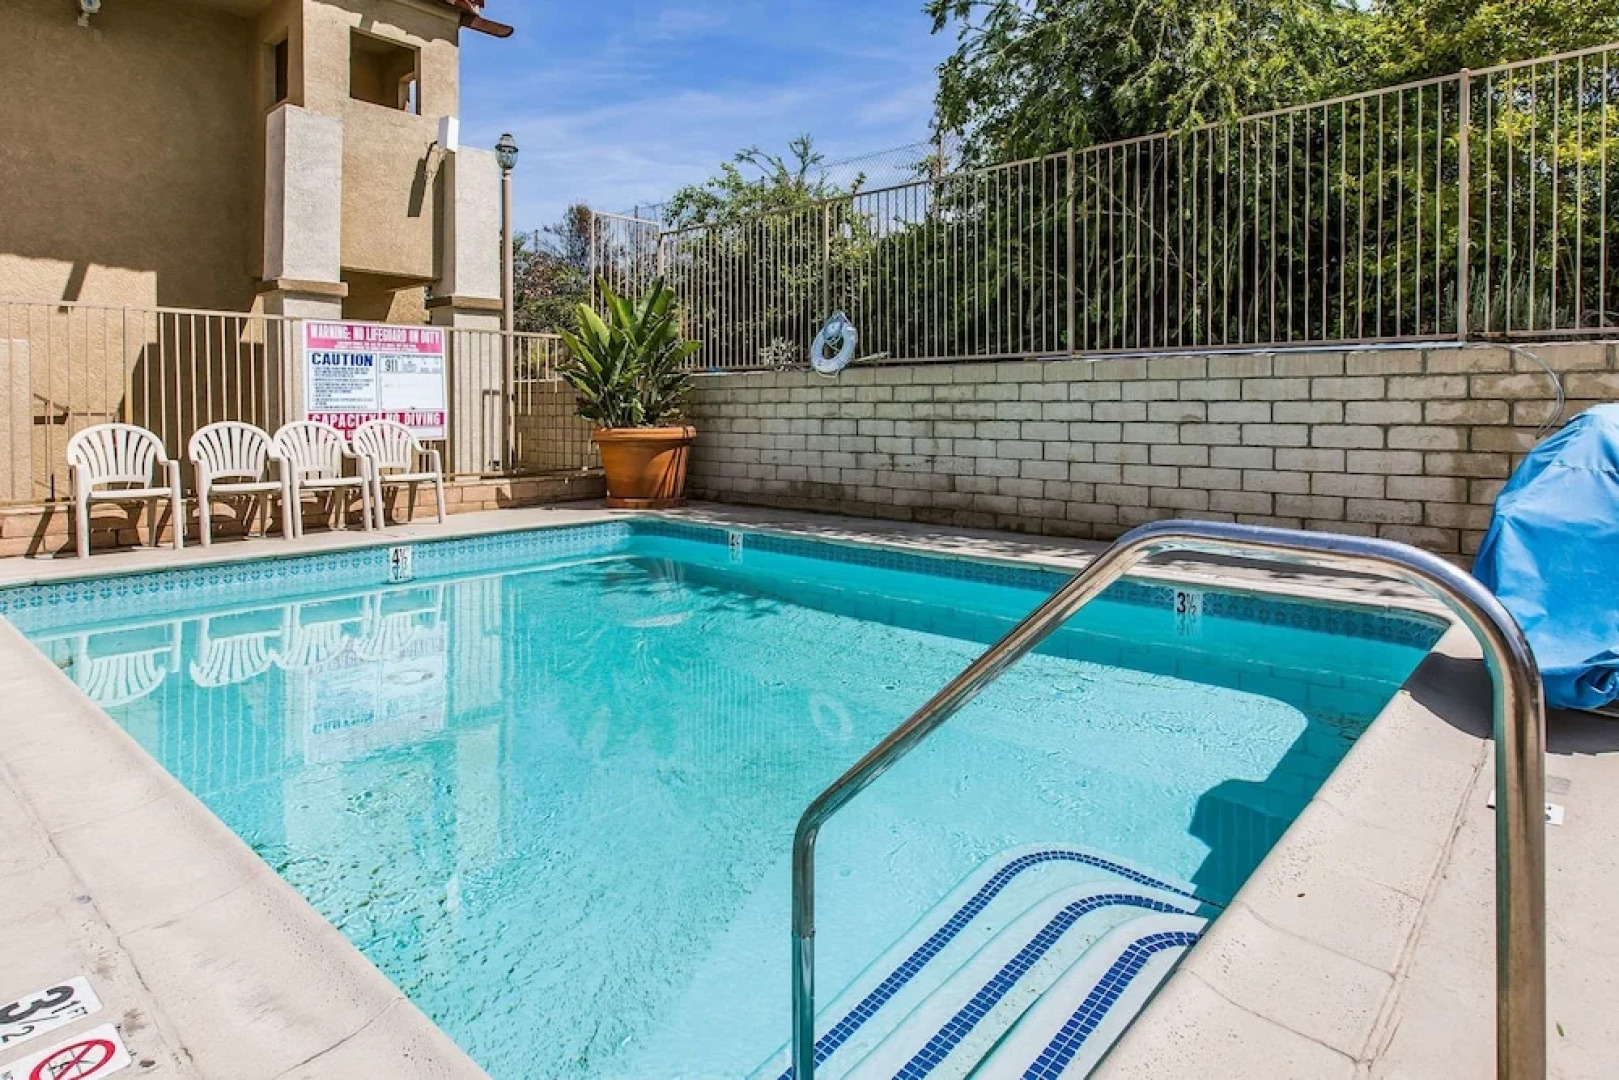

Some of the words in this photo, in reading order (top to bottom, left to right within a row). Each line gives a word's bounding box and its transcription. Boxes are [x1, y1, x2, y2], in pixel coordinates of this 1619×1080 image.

[366, 326, 406, 342] LIFEGUARD
[421, 330, 440, 344] DUTY
[312, 352, 373, 367] CAUTION
[385, 359, 398, 371] 911
[404, 412, 440, 426] DIVING
